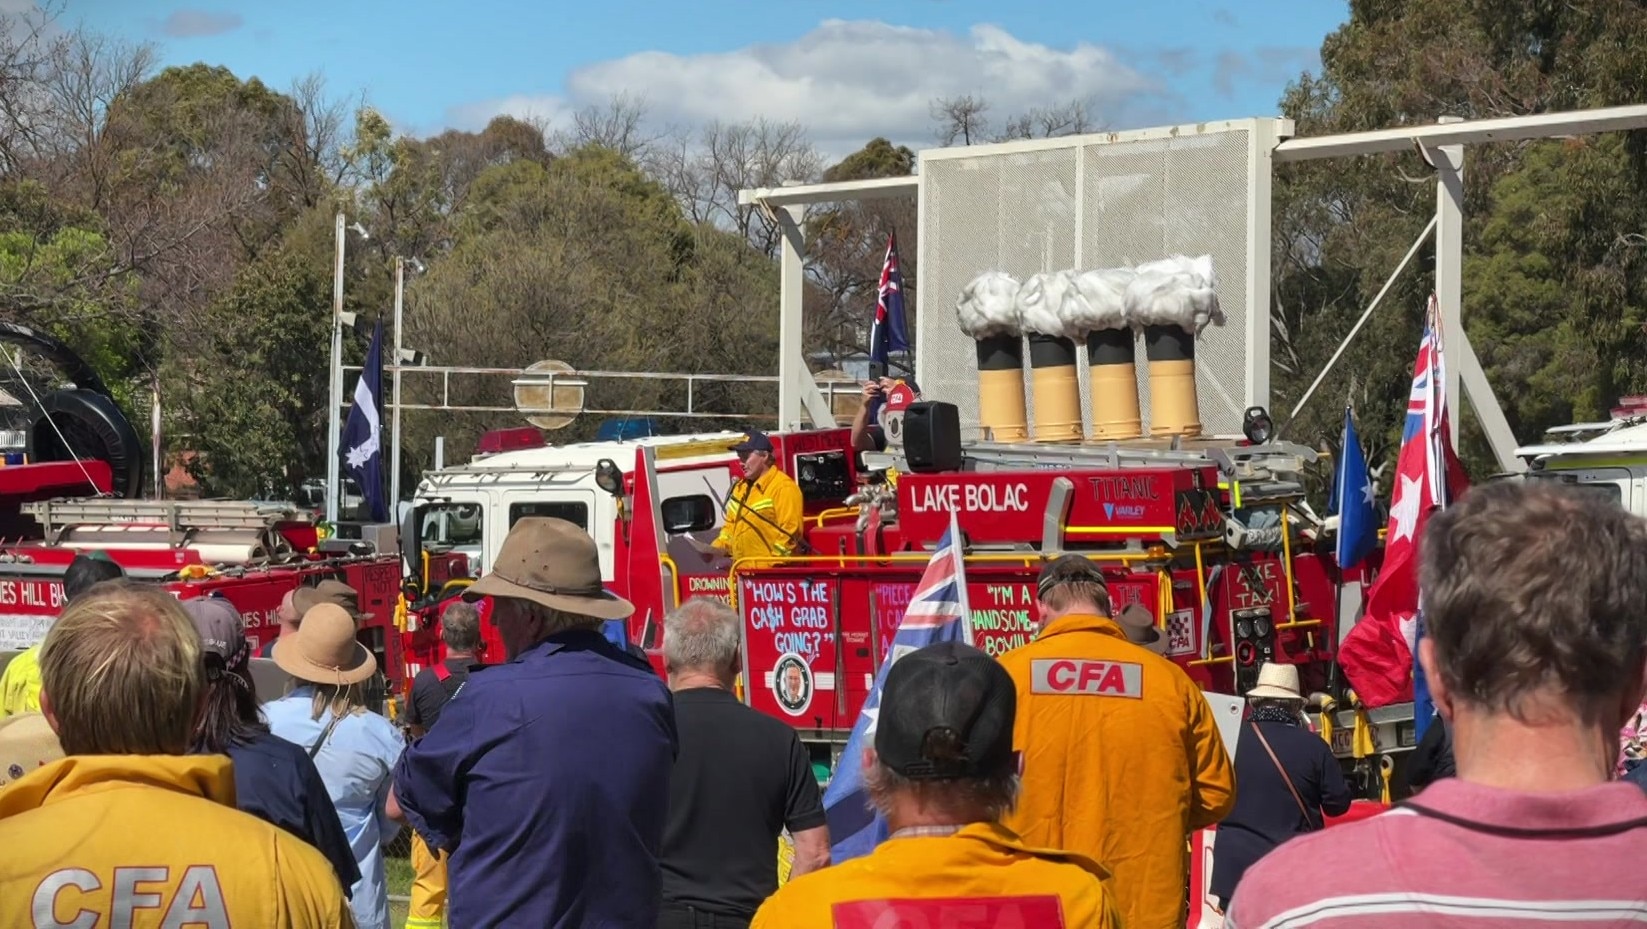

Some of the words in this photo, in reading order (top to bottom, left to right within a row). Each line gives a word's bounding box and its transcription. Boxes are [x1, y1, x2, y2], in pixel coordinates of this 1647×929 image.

[910, 484, 961, 512] LAKE
[965, 483, 1028, 511] BOLAC
[1088, 476, 1159, 501] TITANIC
[1115, 505, 1145, 516] VARLEY
[689, 577, 737, 592] DROWNIN
[1236, 563, 1277, 584] AXE
[20, 581, 47, 606] HILL
[799, 581, 829, 603] THE
[1021, 584, 1032, 606] A
[750, 602, 785, 633] CA$H
[790, 605, 828, 629] GRAB
[971, 608, 1032, 633] HANDSOME
[1046, 659, 1126, 694] CFA
[30, 864, 232, 929] CFA
